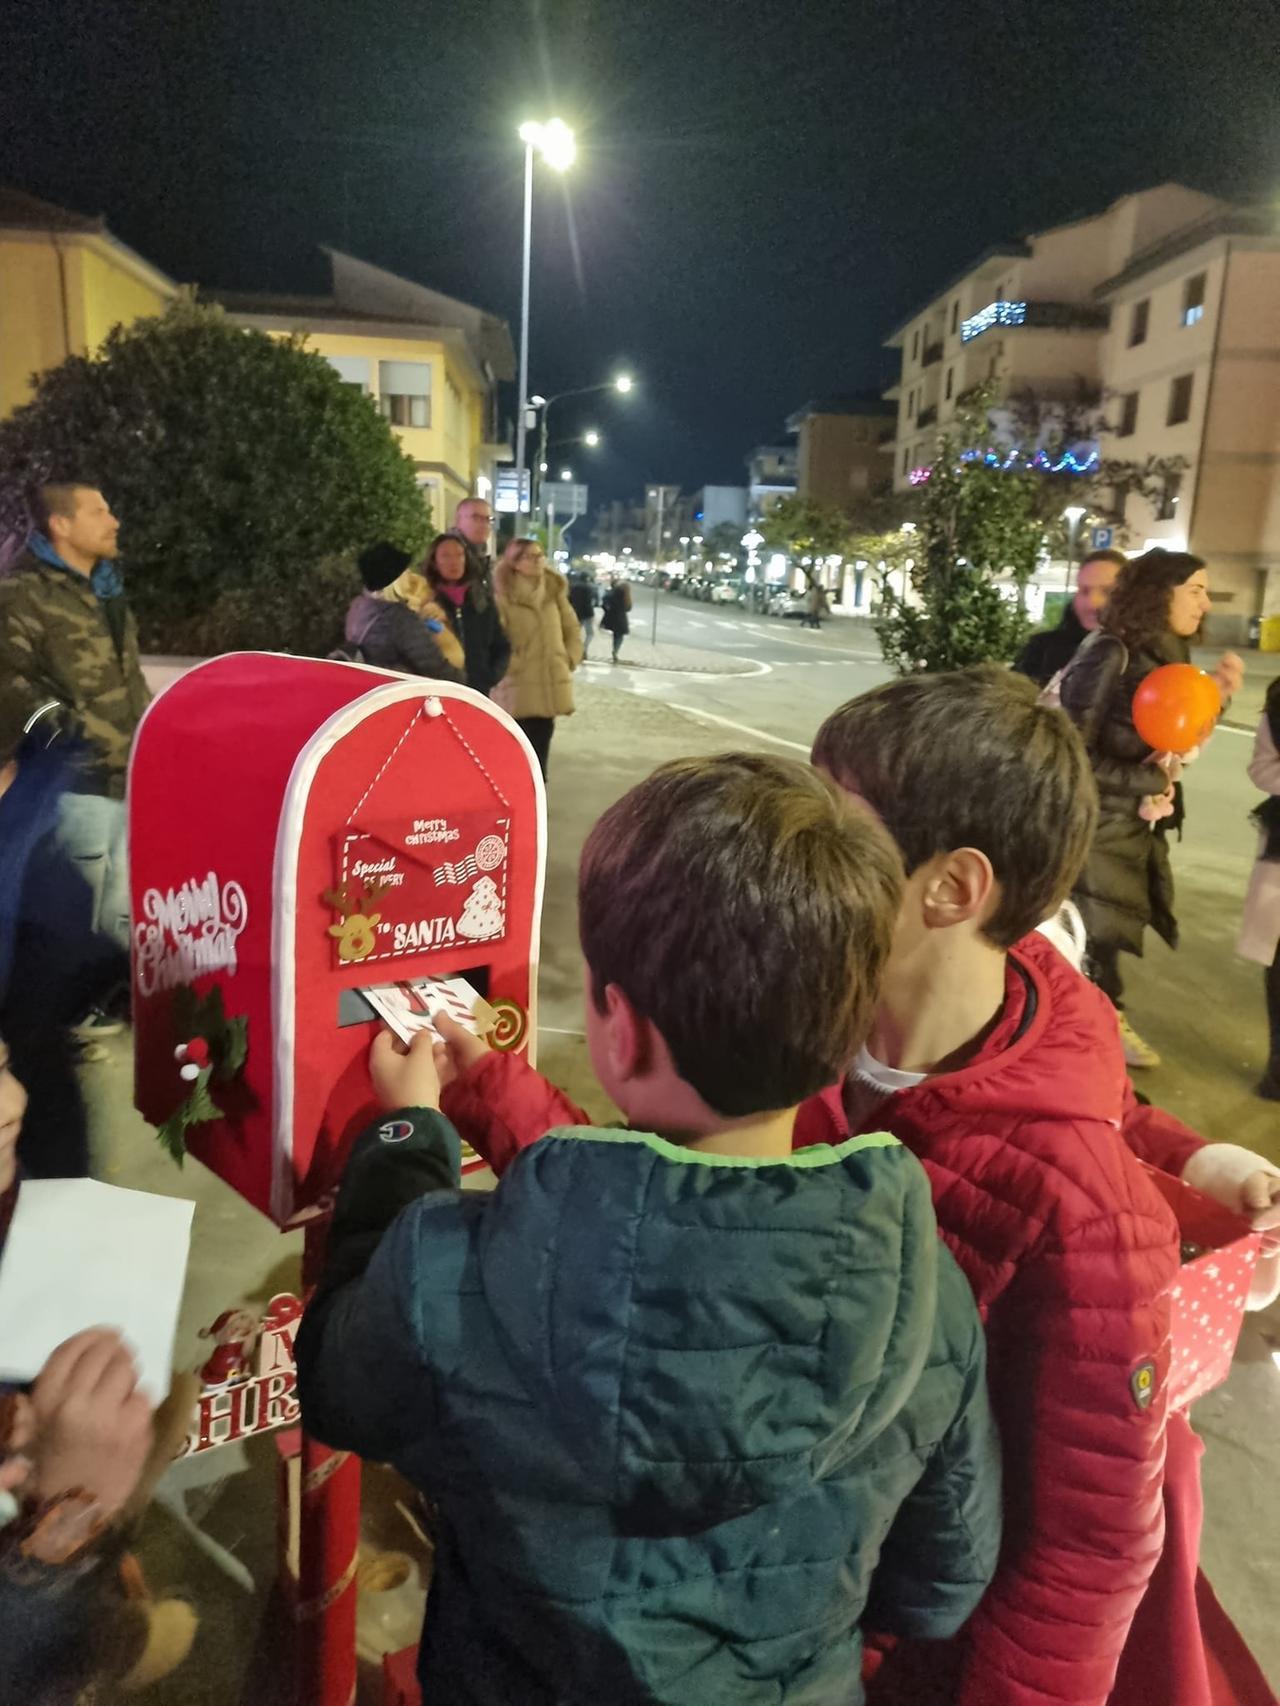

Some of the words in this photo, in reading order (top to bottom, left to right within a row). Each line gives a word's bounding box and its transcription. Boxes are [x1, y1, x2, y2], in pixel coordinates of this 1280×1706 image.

[1095, 530, 1109, 547] P
[413, 819, 447, 833] Merry
[352, 857, 396, 878] Special
[394, 916, 456, 950] SANTA
